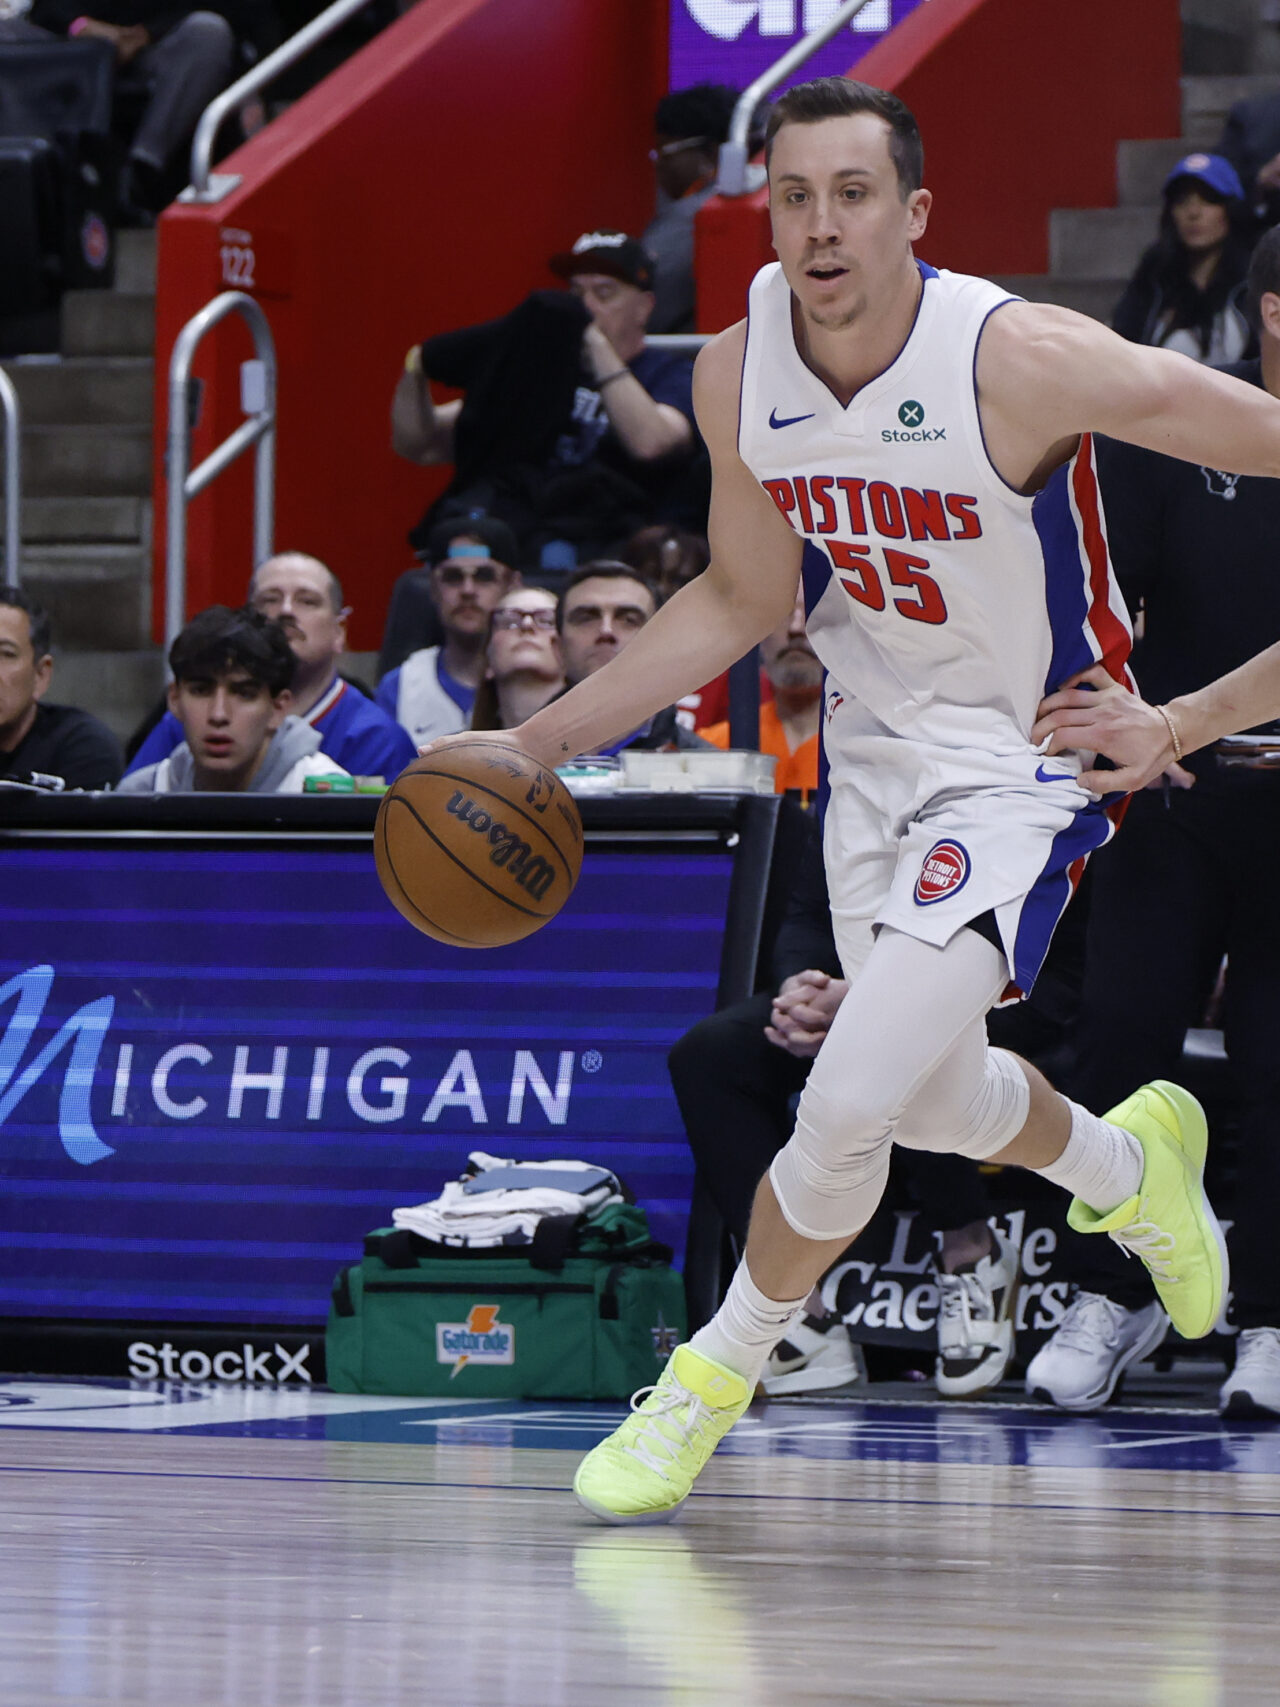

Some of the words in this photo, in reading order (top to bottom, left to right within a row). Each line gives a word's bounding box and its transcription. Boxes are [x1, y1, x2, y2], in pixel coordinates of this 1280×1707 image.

[881, 427, 947, 442] StockX
[762, 475, 983, 541] PISTONS
[824, 539, 948, 625] 55
[445, 790, 557, 903] Wilson
[922, 869, 952, 888] PISTONS
[926, 858, 958, 878] DETROIT
[443, 1329, 510, 1351] Gatorade
[128, 1341, 311, 1383] StockX
